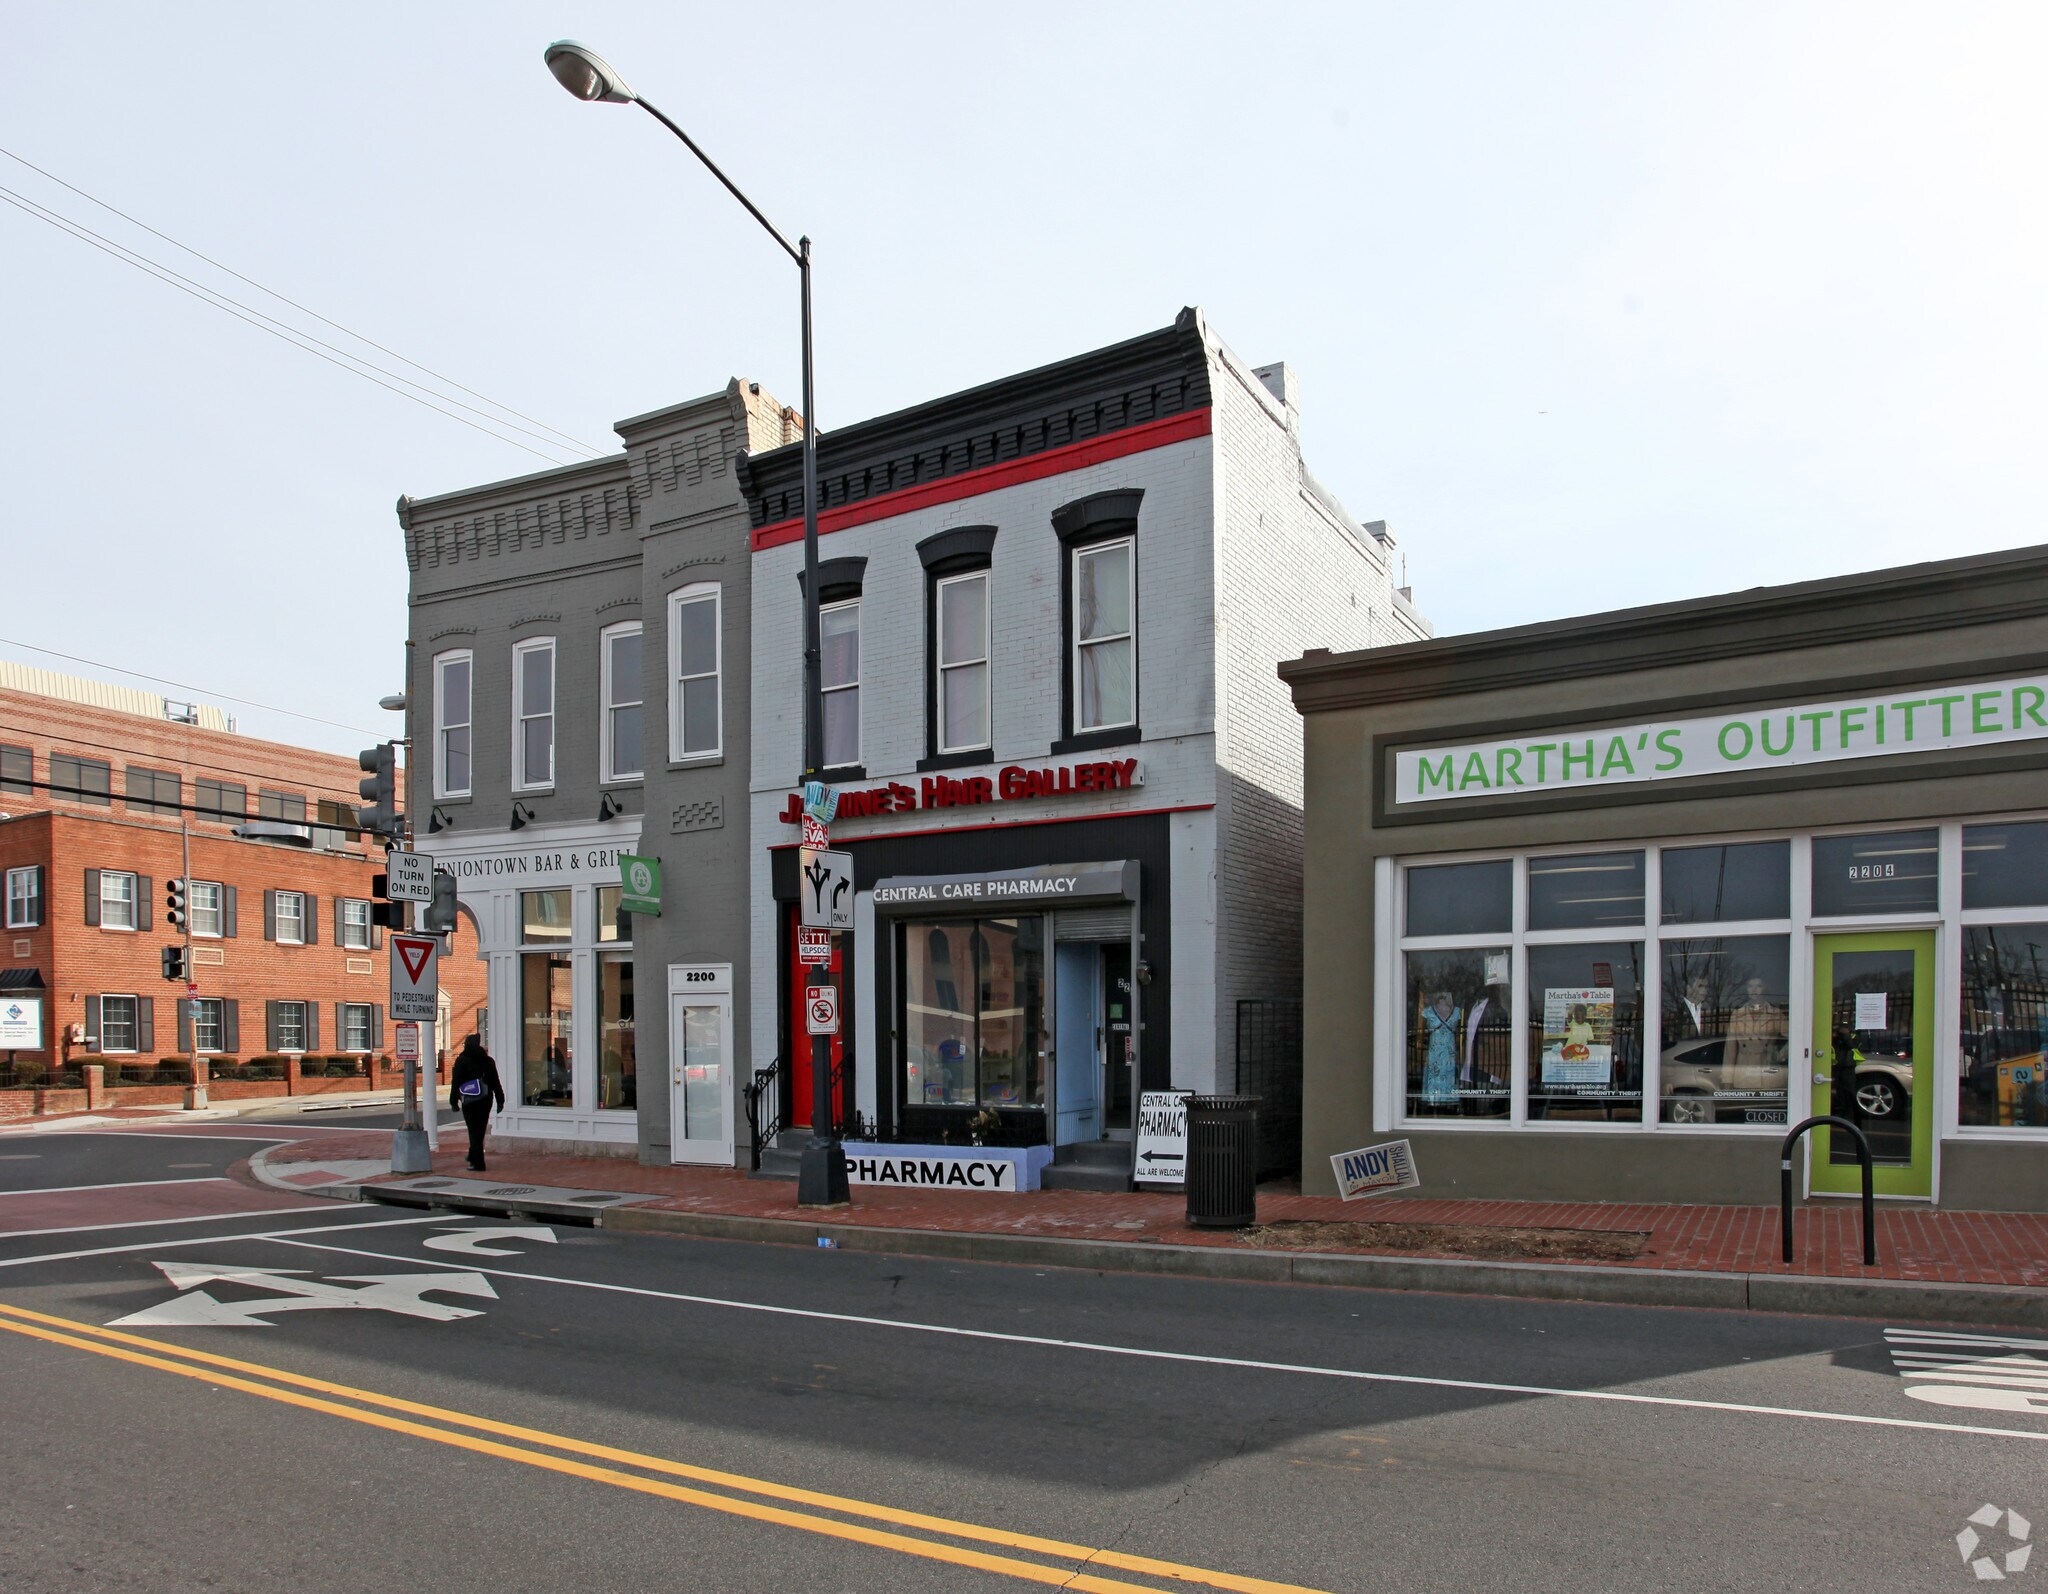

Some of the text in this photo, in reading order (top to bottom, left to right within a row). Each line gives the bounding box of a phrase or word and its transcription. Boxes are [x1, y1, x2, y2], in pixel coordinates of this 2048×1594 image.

[1417, 685, 2048, 794] MARTHA'S OUTFITTER
[779, 758, 1138, 824] JINE'S HAIR GALLERY
[803, 829, 829, 844] EVA
[404, 857, 418, 868] NO
[437, 849, 631, 877] UNIONTOWN BAR & GRIL
[398, 870, 424, 881] TURN
[1850, 865, 1893, 878] 2204
[391, 882, 430, 895] ON RED
[872, 878, 1077, 901] CENTRAL CARE PHARMACY
[833, 912, 848, 922] ONLY
[409, 951, 420, 959] YIELD
[686, 972, 715, 981] 2200
[394, 992, 434, 1003] TO PEDESTRIANS
[1548, 991, 1611, 1000] Martha's Table
[395, 1004, 434, 1014] WHILE TURNING
[1142, 1095, 1186, 1107] CENTRAL CA
[1745, 1111, 1787, 1122] CLOSED
[1139, 1111, 1188, 1137] PHARMACY
[1344, 1149, 1390, 1181] ANDY
[1389, 1145, 1410, 1183] SHALLAL
[845, 1158, 1008, 1187] PHARMACY
[1148, 1168, 1157, 1176] ARE
[1159, 1168, 1184, 1177] WELCOME
[1362, 1176, 1395, 1187] MAYOR
